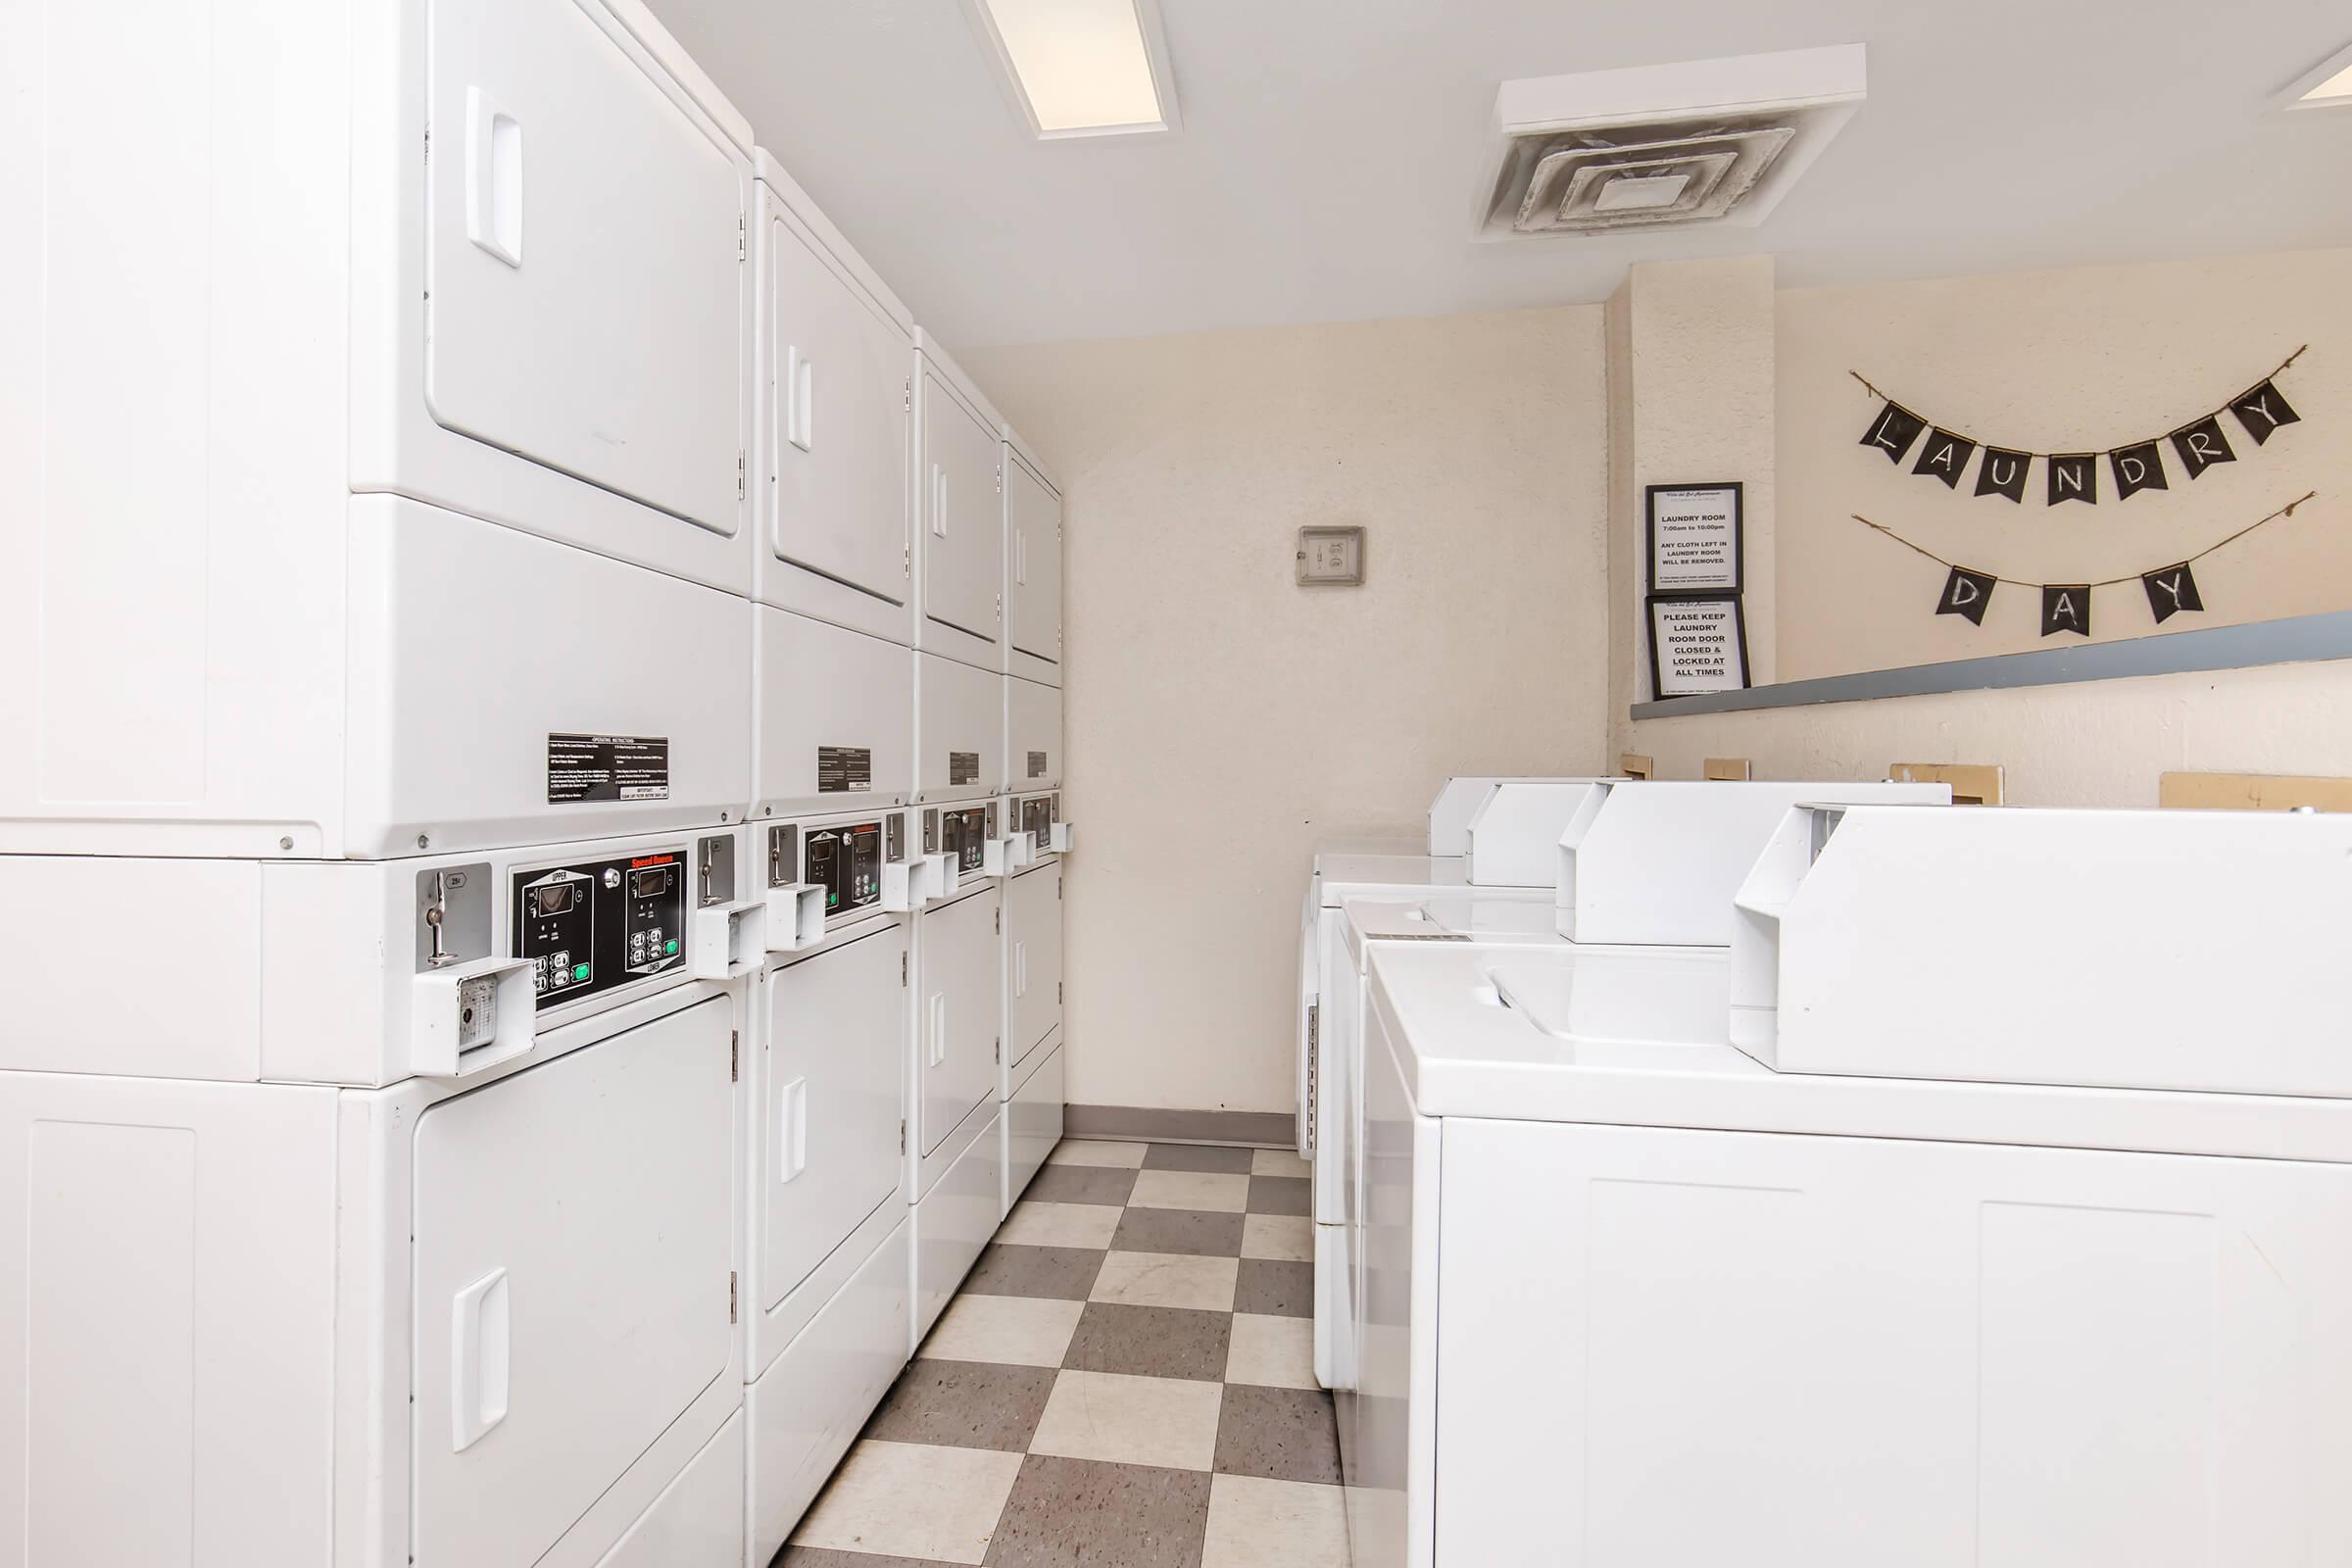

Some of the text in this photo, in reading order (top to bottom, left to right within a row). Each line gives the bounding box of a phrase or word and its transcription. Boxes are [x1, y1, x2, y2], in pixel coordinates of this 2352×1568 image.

[1873, 393, 2278, 493] LAUNDRY
[1951, 573, 2182, 628] DAY
[553, 871, 566, 881] UPPER
[647, 962, 660, 972] LOWER
